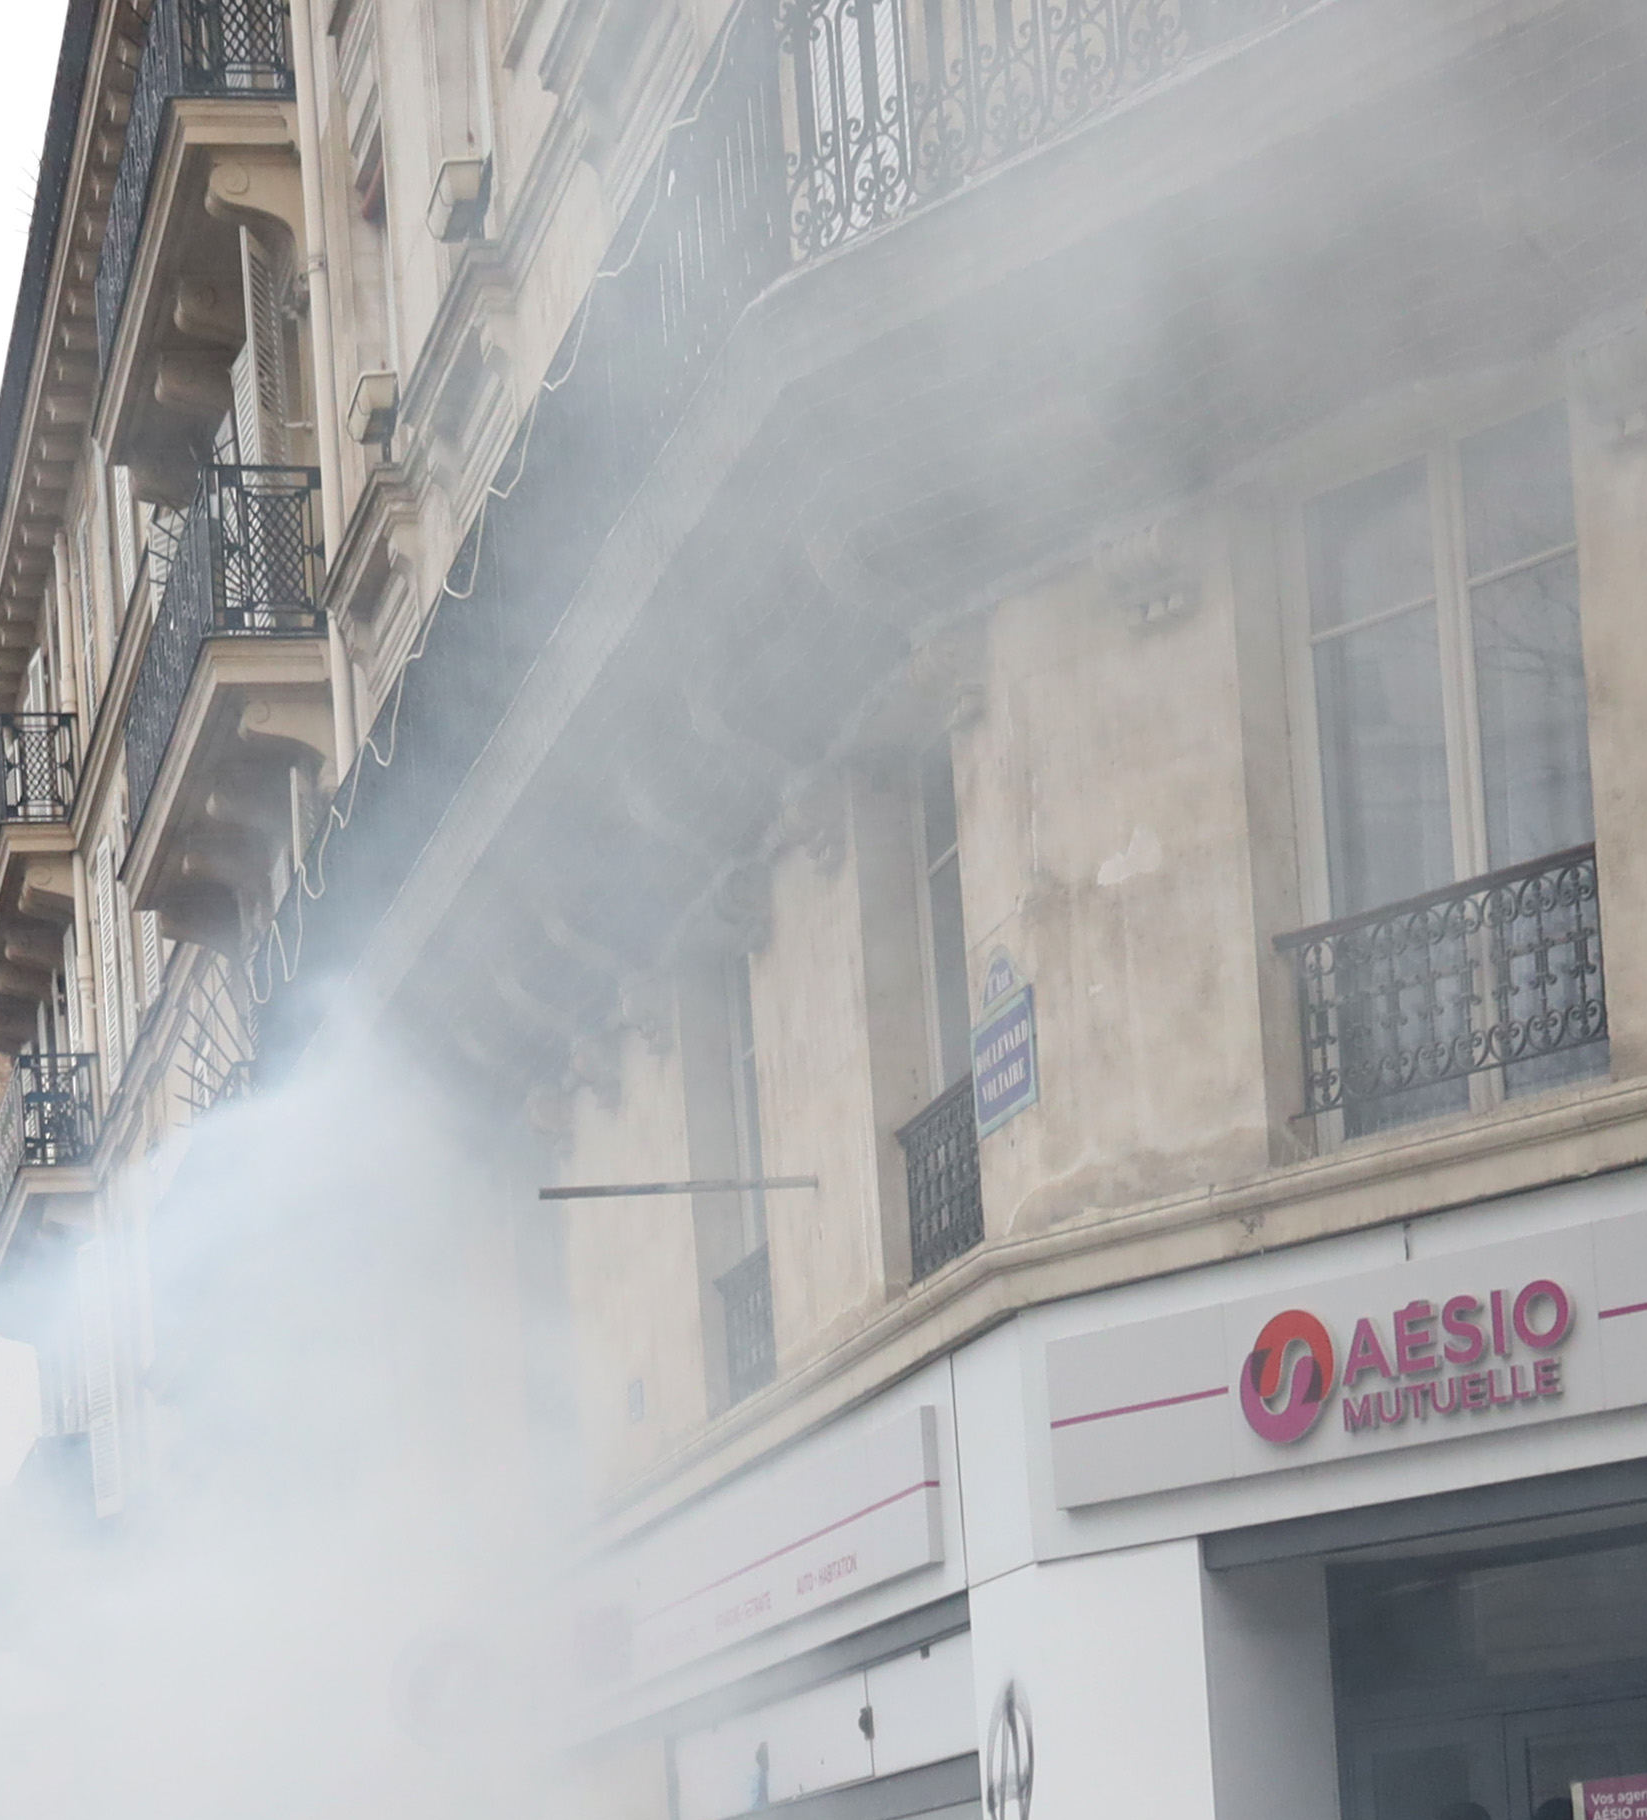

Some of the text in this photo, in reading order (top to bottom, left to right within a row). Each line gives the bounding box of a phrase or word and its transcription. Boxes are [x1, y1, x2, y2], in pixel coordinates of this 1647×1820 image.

[976, 1019, 1029, 1077] BOULEVARD
[981, 1057, 1026, 1104] VOLTAIRE
[1342, 1280, 1572, 1387] AÉSIO
[1342, 1358, 1562, 1433] MUTUELLE
[1591, 1792, 1615, 1806] Vos
